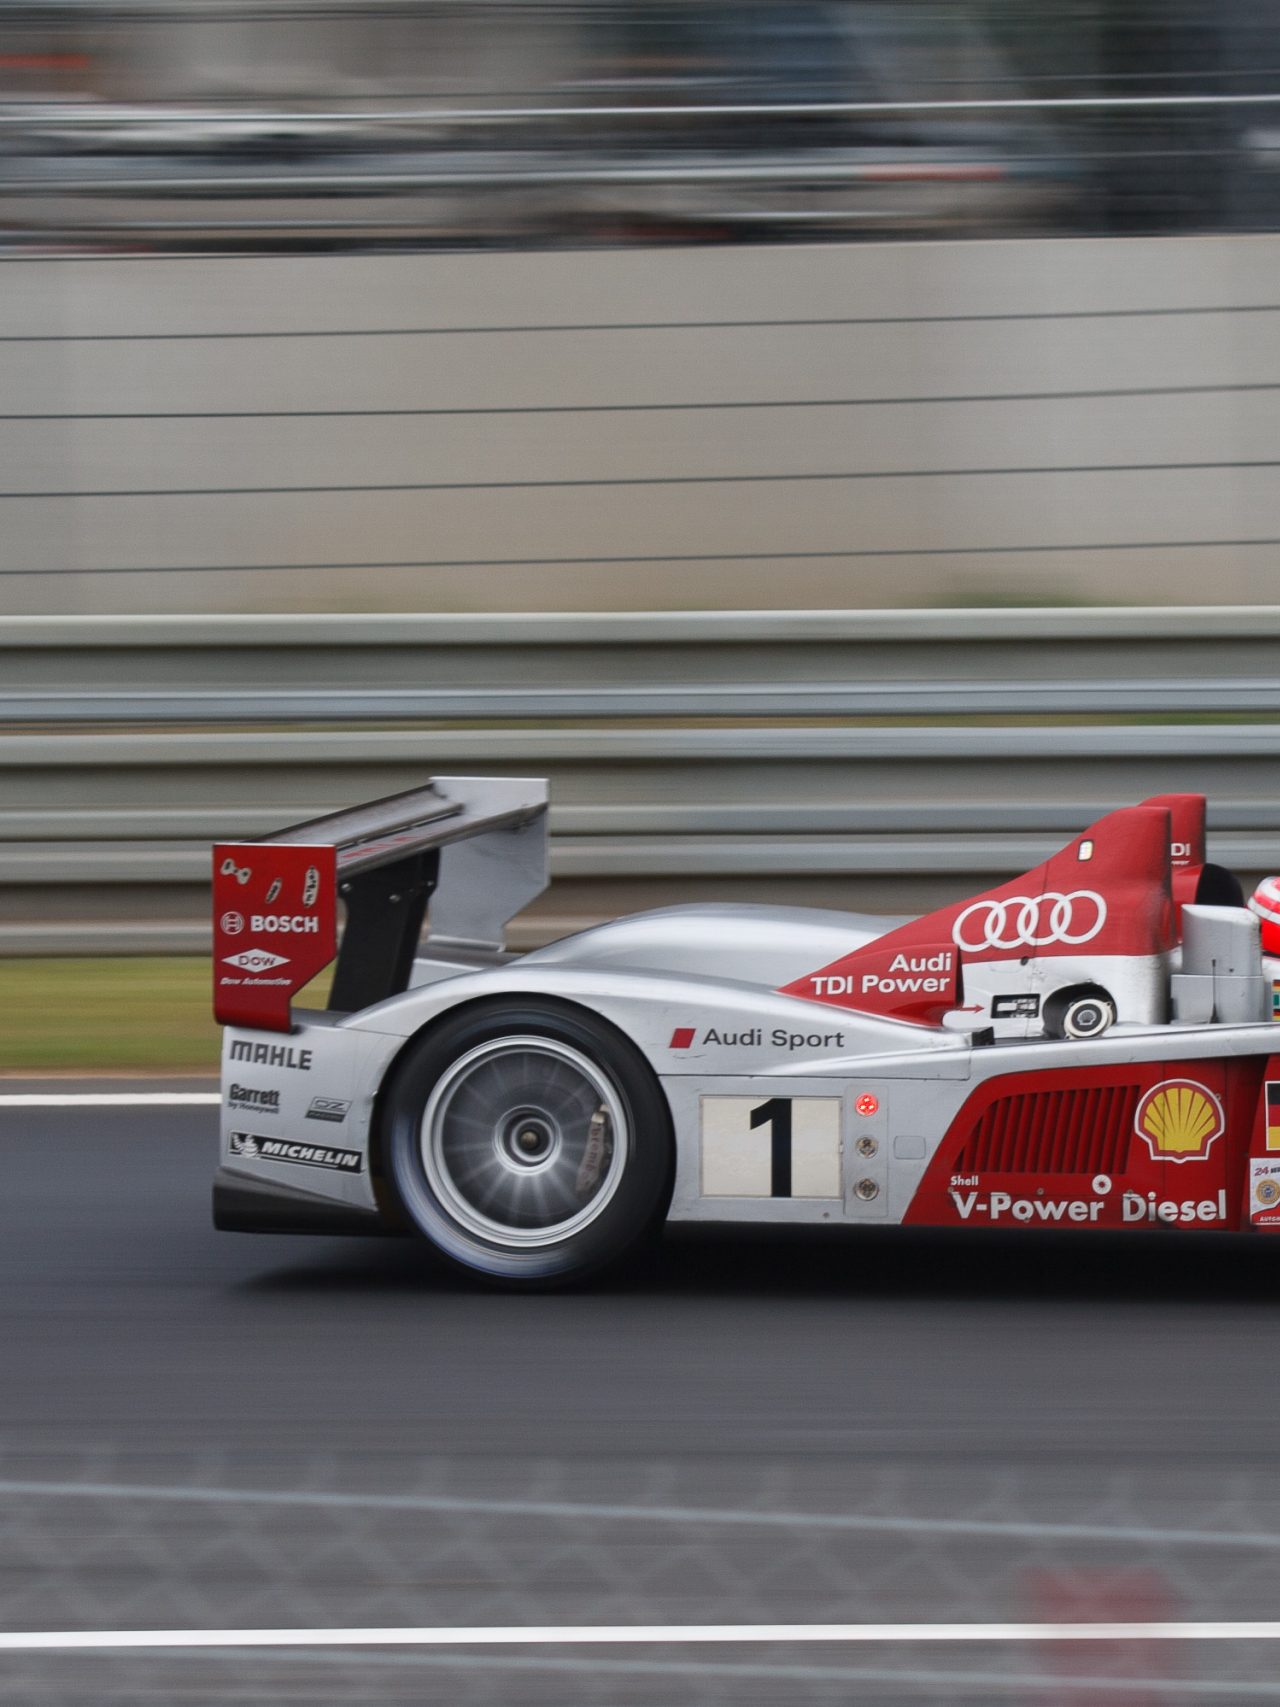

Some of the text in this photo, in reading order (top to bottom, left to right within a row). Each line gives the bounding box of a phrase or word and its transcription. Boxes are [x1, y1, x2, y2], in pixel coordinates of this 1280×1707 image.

[1171, 843, 1191, 857] DI
[250, 915, 319, 933] BOSCH
[888, 952, 952, 972] Audi
[810, 974, 951, 996] TDI Power
[702, 1028, 845, 1051] Audi Sport
[229, 1040, 313, 1071] MAHLE
[229, 1083, 280, 1107] Garrett
[261, 1141, 359, 1167] MICHELIN
[749, 1097, 793, 1198] 1
[950, 1175, 979, 1186] Shell
[1254, 1166, 1269, 1176] 24
[951, 1189, 1227, 1222] V-Power Diesel
